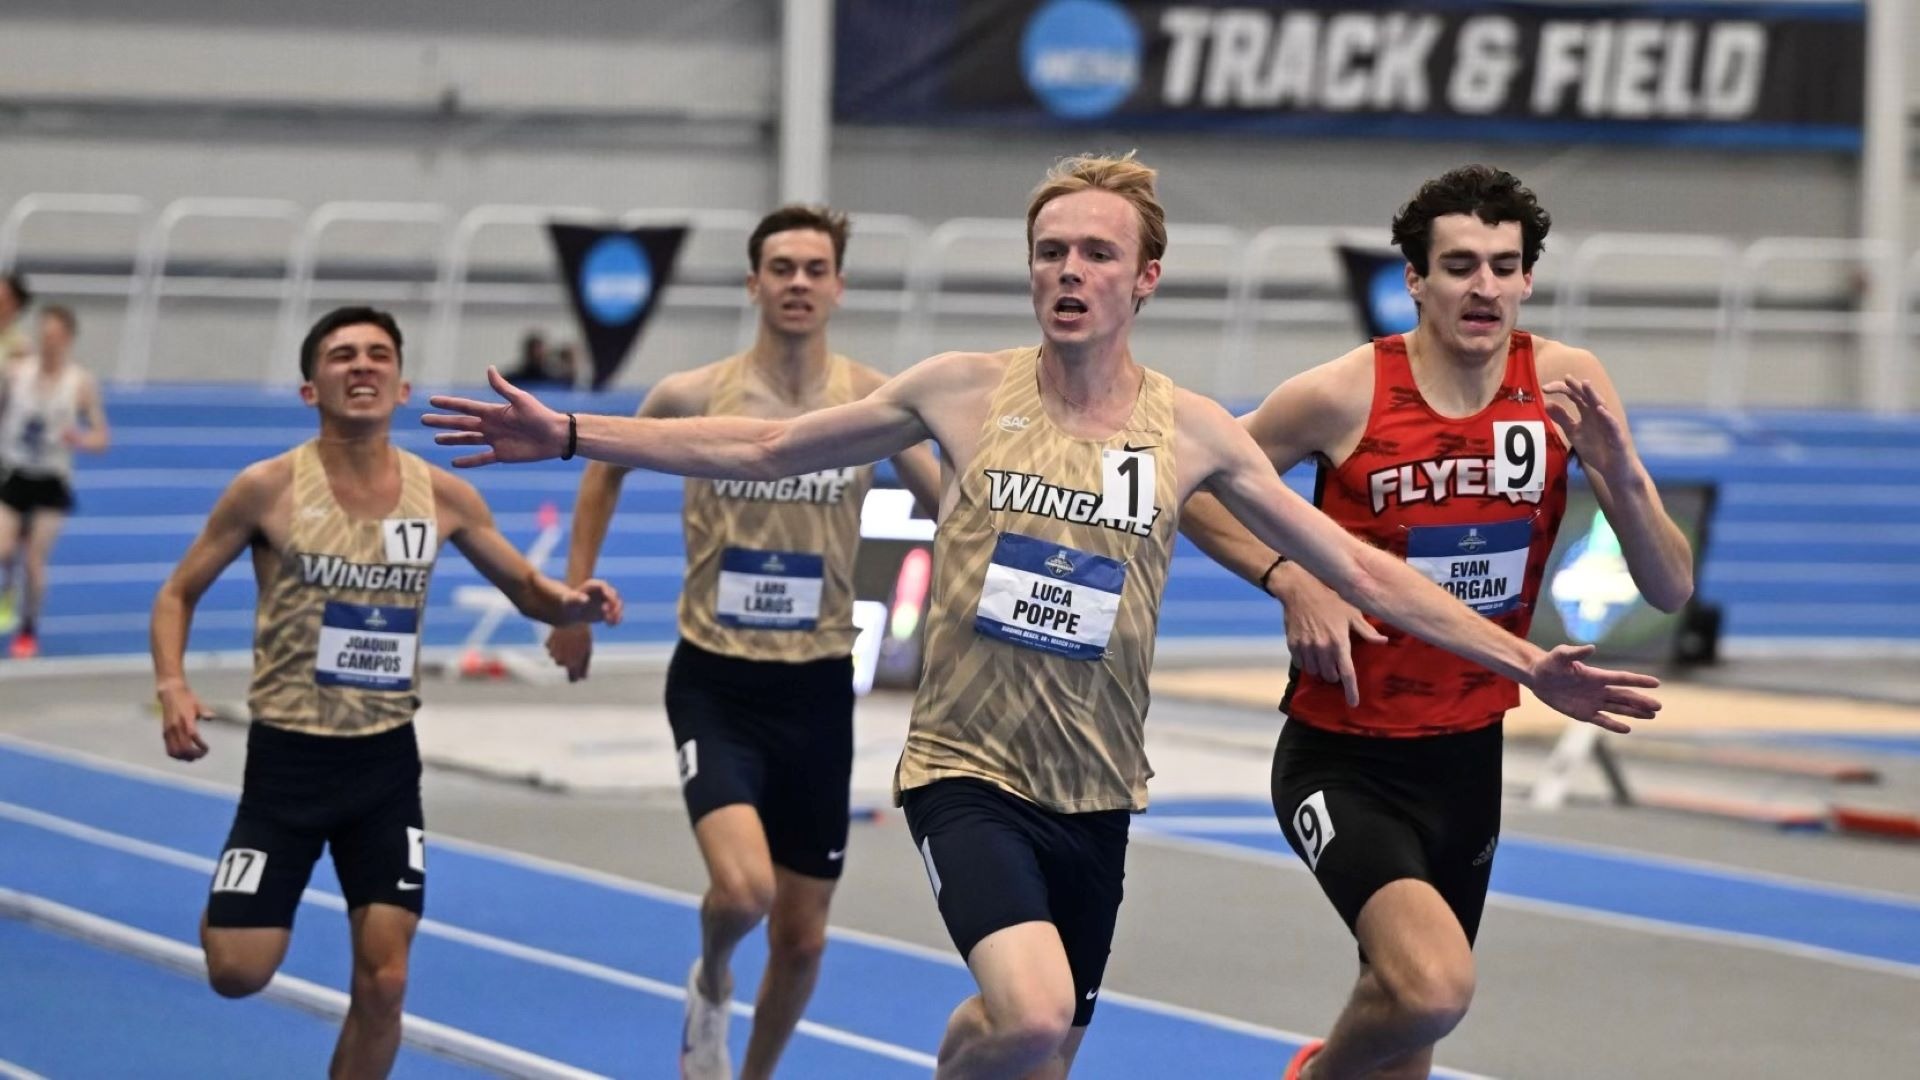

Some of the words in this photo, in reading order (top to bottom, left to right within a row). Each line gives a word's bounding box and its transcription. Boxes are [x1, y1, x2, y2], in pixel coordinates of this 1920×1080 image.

[1160, 10, 1442, 109] TRACK
[1448, 15, 1520, 113] &
[1530, 20, 1768, 118] FIELD
[1000, 416, 1030, 429] SAC
[1505, 425, 1535, 489] 9
[1117, 456, 1139, 518] 1
[395, 522, 427, 559] 17
[299, 554, 428, 592] WINGATE
[1451, 560, 1490, 578] EVAN
[1030, 581, 1072, 607] LUCA
[1438, 577, 1507, 600] ORGAN
[1012, 600, 1081, 634] POPPE
[337, 652, 401, 673] CAMPOS
[1299, 804, 1322, 860] 9
[222, 851, 255, 888] 17
